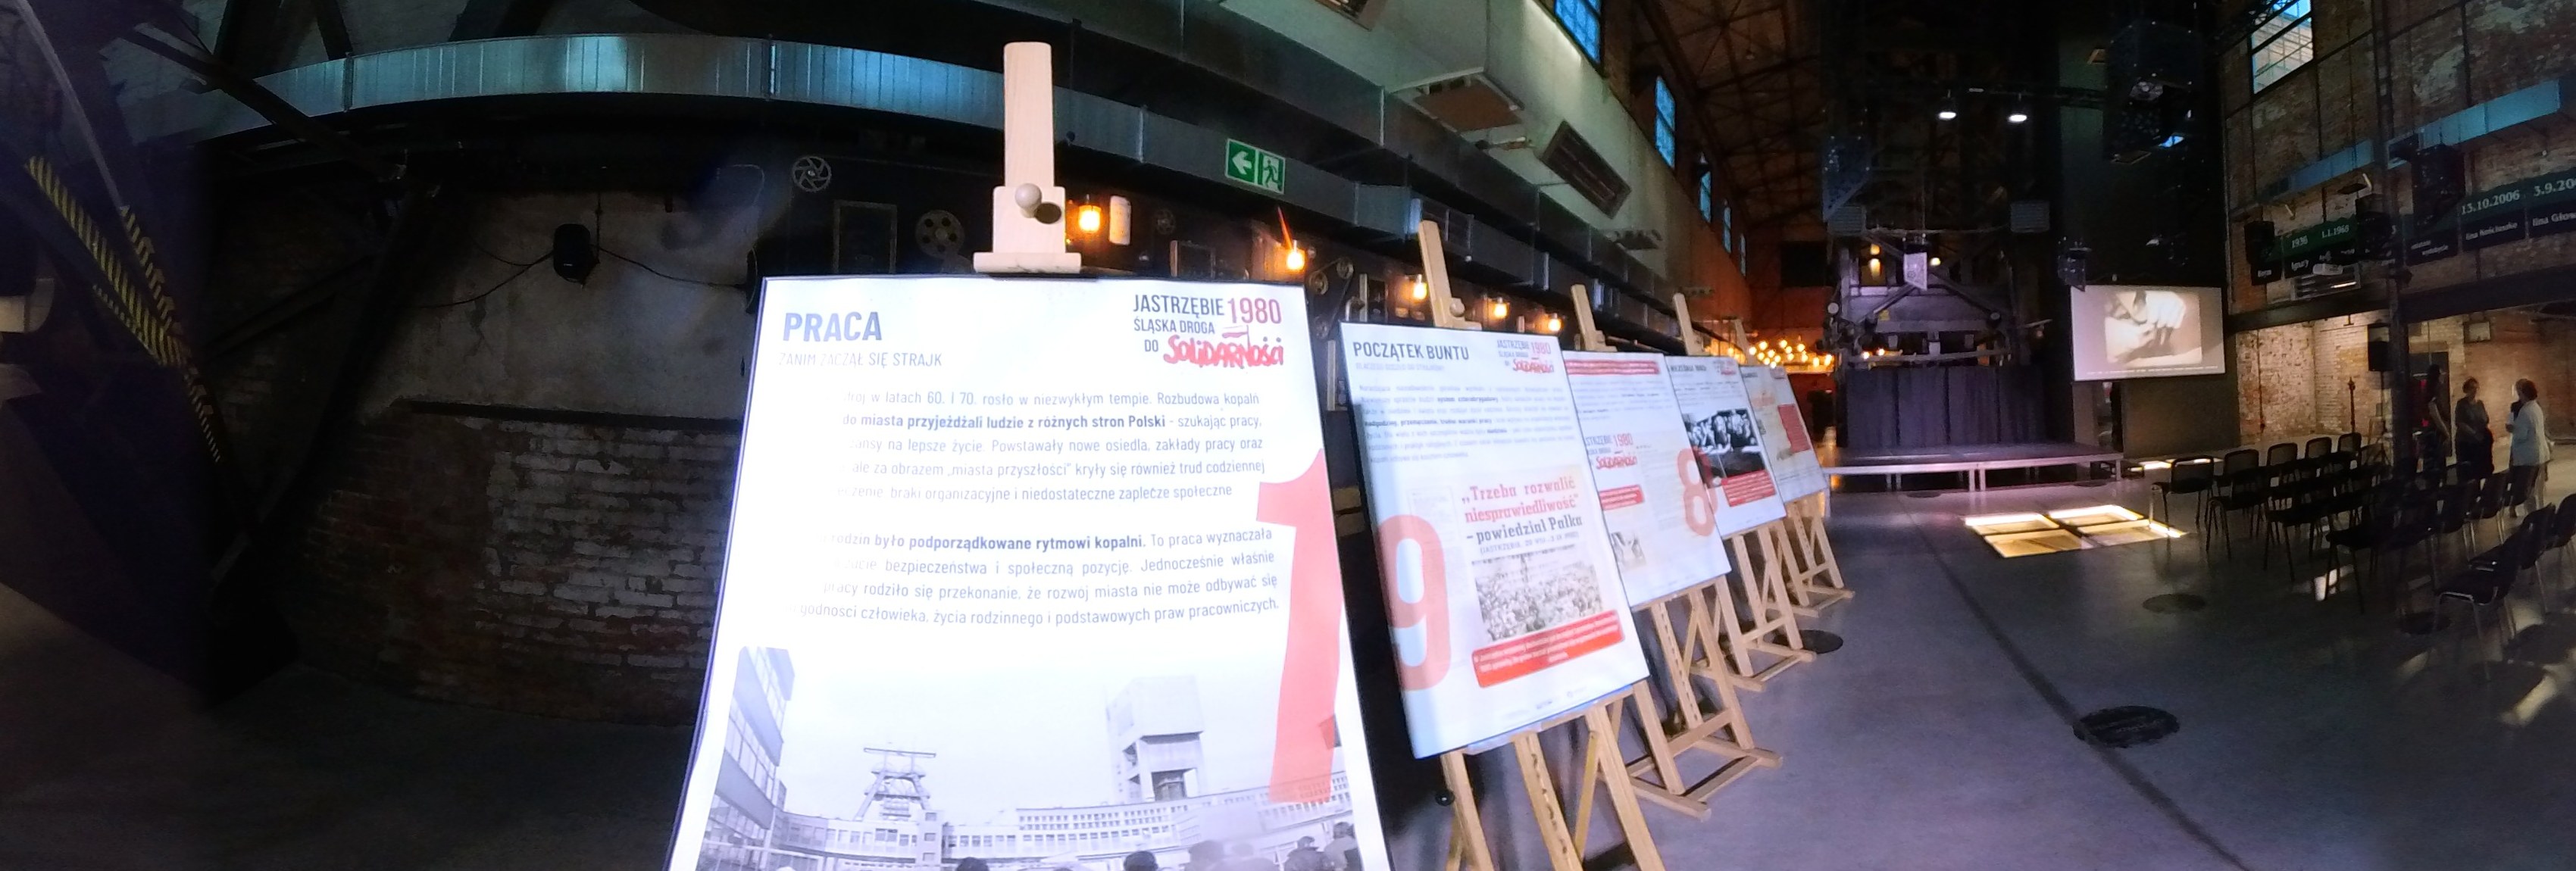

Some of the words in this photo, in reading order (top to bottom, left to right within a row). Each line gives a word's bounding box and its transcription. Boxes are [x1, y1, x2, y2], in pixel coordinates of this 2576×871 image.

[2533, 178, 2576, 197] 3.9.20
[1133, 294, 1225, 318] JASTRZĘBIE
[1227, 298, 1282, 324] 1980
[783, 311, 883, 342] PRACA
[1133, 317, 1177, 334] ŚLĄSKA
[1180, 320, 1215, 334] DROGA
[1144, 339, 1159, 352] DO
[1352, 342, 1424, 361] POCZĄTEK
[1426, 345, 1470, 361] BUNTU
[779, 352, 817, 367] ZANIM
[821, 352, 864, 369] ZACZĄŁ
[868, 351, 889, 369] SIĘ
[893, 351, 943, 367] STRAJK
[871, 393, 880, 403] w
[886, 391, 921, 404] latach
[927, 392, 946, 404] 60.
[959, 392, 977, 405] 70.
[983, 392, 1014, 406] rosło
[1019, 395, 1029, 406] w
[1033, 392, 1104, 407] niezwykłym
[1109, 393, 1152, 407] tempie.
[1157, 392, 1220, 405] Rozbudowa
[1224, 392, 1259, 407] kopalń
[843, 414, 857, 426] do
[861, 414, 904, 426] miasta
[907, 414, 983, 430] przyjeżdżali
[986, 416, 1024, 429] ludzie
[1027, 417, 1034, 429] z
[1038, 415, 1088, 430] różnych
[1092, 417, 1125, 429] stron
[1128, 415, 1166, 429] Polski
[1177, 415, 1226, 430] szukając
[1230, 416, 1262, 430] pracy,
[888, 440, 902, 451] na
[908, 438, 946, 454] lepsze
[952, 440, 986, 455] życie.
[992, 439, 1063, 454] Powstawały
[1069, 441, 1100, 451] nowe
[1105, 439, 1151, 452] osiedla,
[1155, 439, 1200, 453] zakłady
[1205, 439, 1235, 453] pracy
[1240, 439, 1263, 449] oraz
[852, 460, 870, 474] ale
[874, 464, 888, 475] za
[891, 462, 944, 476] obrazem
[1075, 462, 1106, 479] kryły
[1110, 463, 1127, 477] się
[1131, 461, 1176, 475] również
[1180, 462, 1202, 474] trud
[1206, 460, 1265, 475] codziennej
[890, 486, 921, 499] braki
[925, 487, 1011, 504] organizacyjne
[1022, 487, 1115, 501] niedostateczne
[1119, 486, 1170, 503] zaplecze
[1174, 485, 1233, 501] społeczne
[1524, 476, 1577, 495] rozwalić
[1476, 518, 1547, 545] powiedział
[1548, 514, 1583, 531] Pałka
[831, 533, 871, 545] rodzin
[874, 534, 905, 549] było
[908, 536, 1032, 552] podporządkowane
[1036, 535, 1091, 553] rytmowi
[1095, 534, 1146, 552] kopalni.
[1151, 534, 1165, 547] To
[1168, 533, 1203, 548] praca
[1207, 527, 1272, 546] wyznaczała
[885, 559, 987, 576] bezpieczeństwa
[1008, 560, 1074, 577] społeczną
[1082, 560, 1133, 577] pozycję.
[1140, 556, 1224, 572] Jednocześnie
[1231, 551, 1275, 567] właśnie
[864, 582, 909, 597] rodziło
[914, 583, 933, 600] się
[939, 584, 1021, 601] przekonanie,
[1027, 585, 1041, 600] że
[1047, 585, 1089, 602] rozwój
[1095, 584, 1138, 598] miasta
[1143, 582, 1162, 596] nie
[1168, 579, 1201, 595] może
[1205, 575, 1258, 593] odbywać
[1261, 573, 1278, 588] się
[861, 606, 930, 623] człowieka,
[933, 608, 967, 626] życia
[971, 610, 1043, 628] rodzinnego
[1055, 608, 1150, 627] podstawowych
[1155, 607, 1185, 623] praw
[1189, 596, 1280, 620] pracowniczych.
[1377, 514, 1452, 691] 9
[1256, 448, 1344, 803] 1
